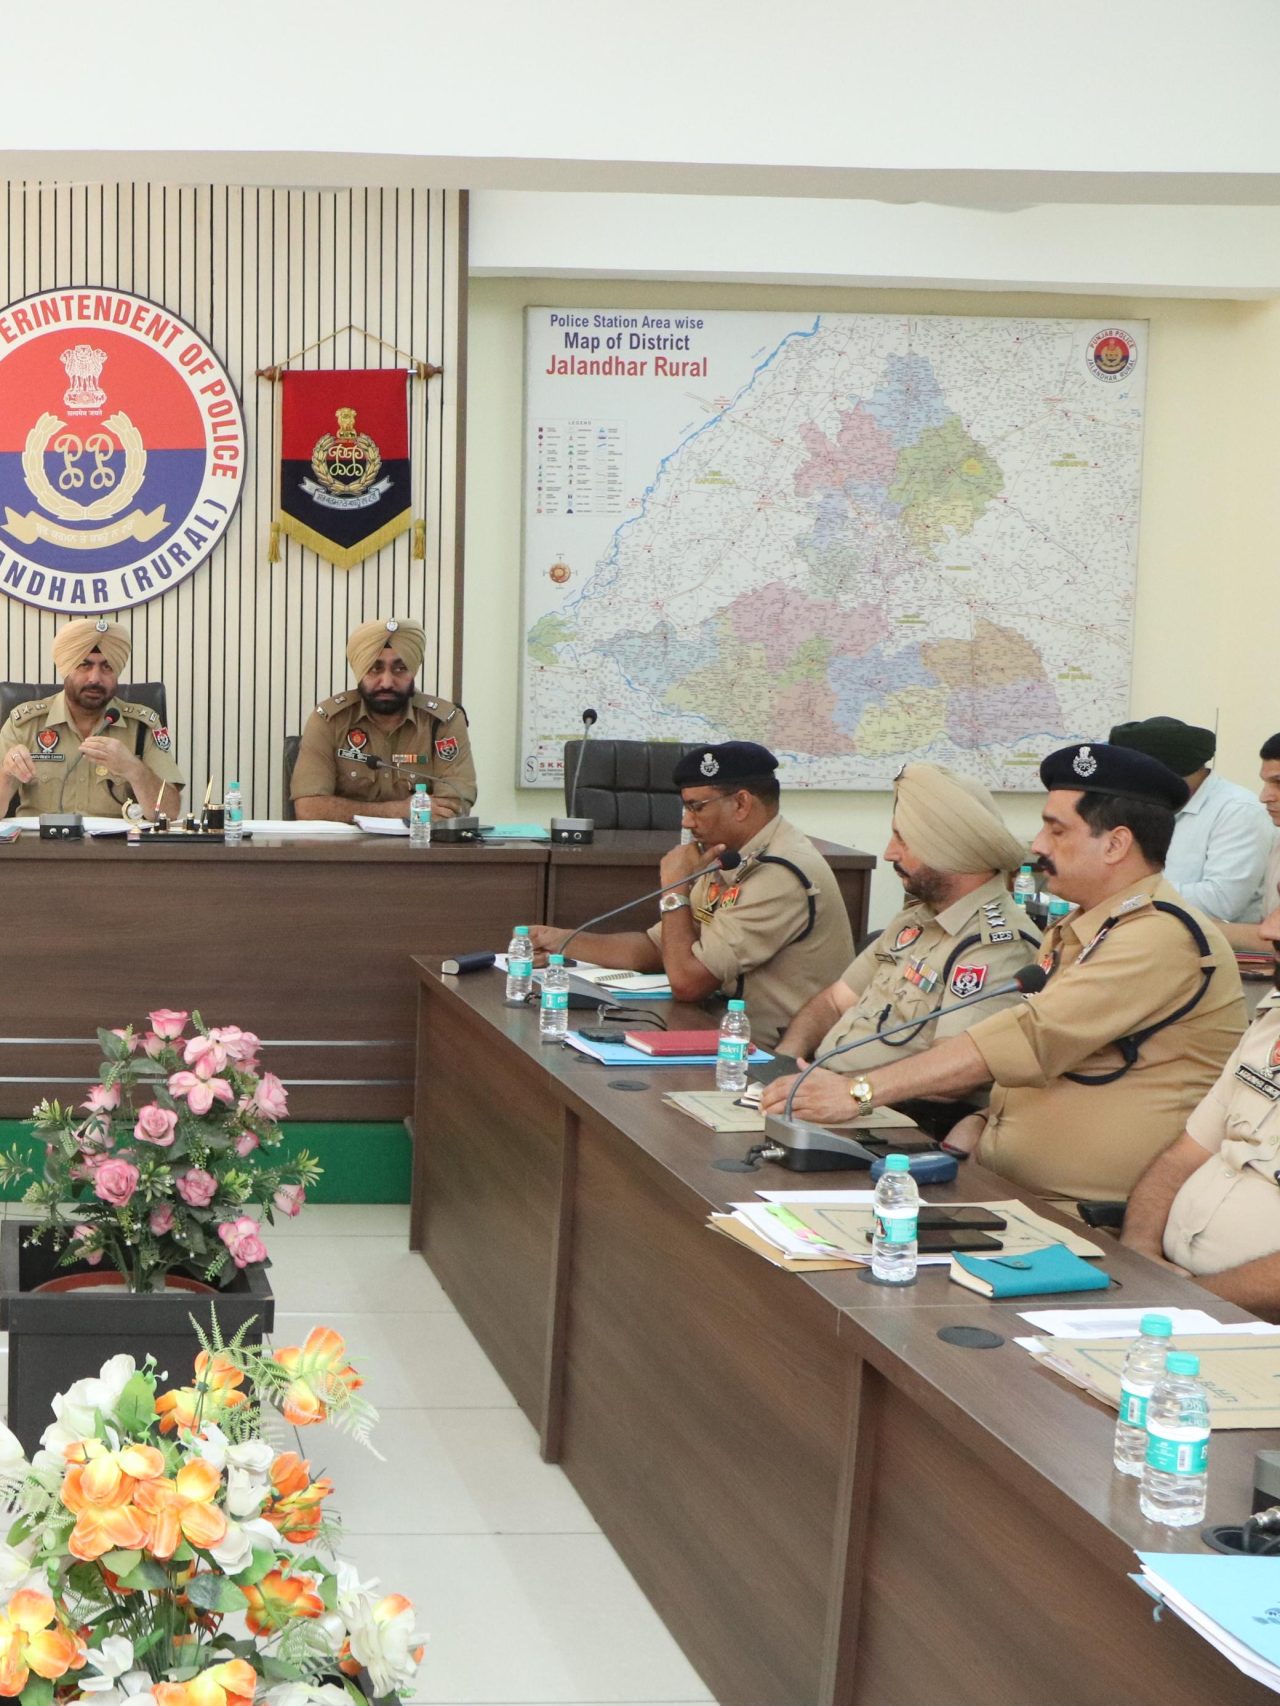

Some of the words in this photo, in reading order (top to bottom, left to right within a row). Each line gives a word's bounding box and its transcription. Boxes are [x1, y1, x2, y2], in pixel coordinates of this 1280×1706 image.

[550, 314, 589, 327] Police
[593, 315, 638, 329] Station
[642, 316, 670, 329] Area
[675, 316, 704, 329] wise
[564, 332, 600, 353] Map
[606, 333, 622, 350] of
[629, 333, 690, 351] District
[1090, 331, 1113, 348] PUNJAB
[1115, 331, 1136, 348] POLICE
[546, 355, 648, 376] Jalandhar
[654, 356, 708, 377] Rural
[1088, 359, 1117, 380] JALANDHAR
[178, 343, 215, 378] OF
[199, 379, 240, 480] POLICE
[121, 498, 228, 599] (RURAL)
